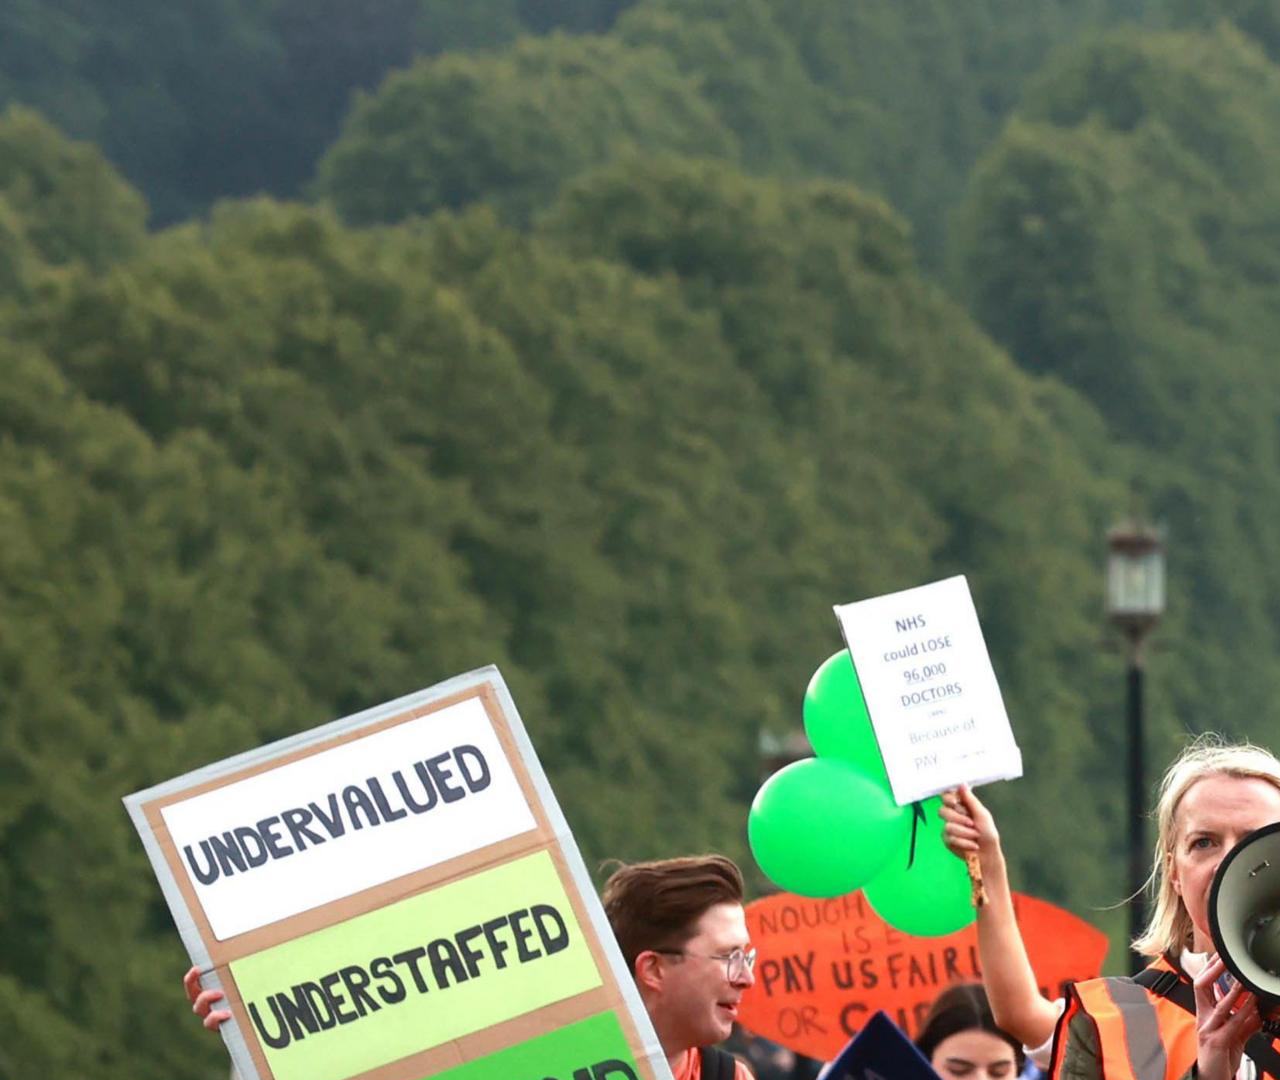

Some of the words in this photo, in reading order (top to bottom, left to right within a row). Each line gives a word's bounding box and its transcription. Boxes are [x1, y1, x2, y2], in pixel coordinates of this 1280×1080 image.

[895, 614, 926, 633] NHS
[884, 643, 918, 663] could
[921, 635, 952, 653] LOSE
[903, 662, 946, 682] 96,000
[901, 682, 962, 707] DOCTORS
[183, 744, 492, 885] UNDERVALUED
[759, 893, 865, 935] NOUGH
[842, 926, 871, 954] IS
[248, 903, 570, 1049] UNDERSTAFFED
[760, 952, 816, 997] PAY
[832, 958, 879, 990] US
[886, 945, 983, 989] FAIRL
[777, 1007, 828, 1039] OR
